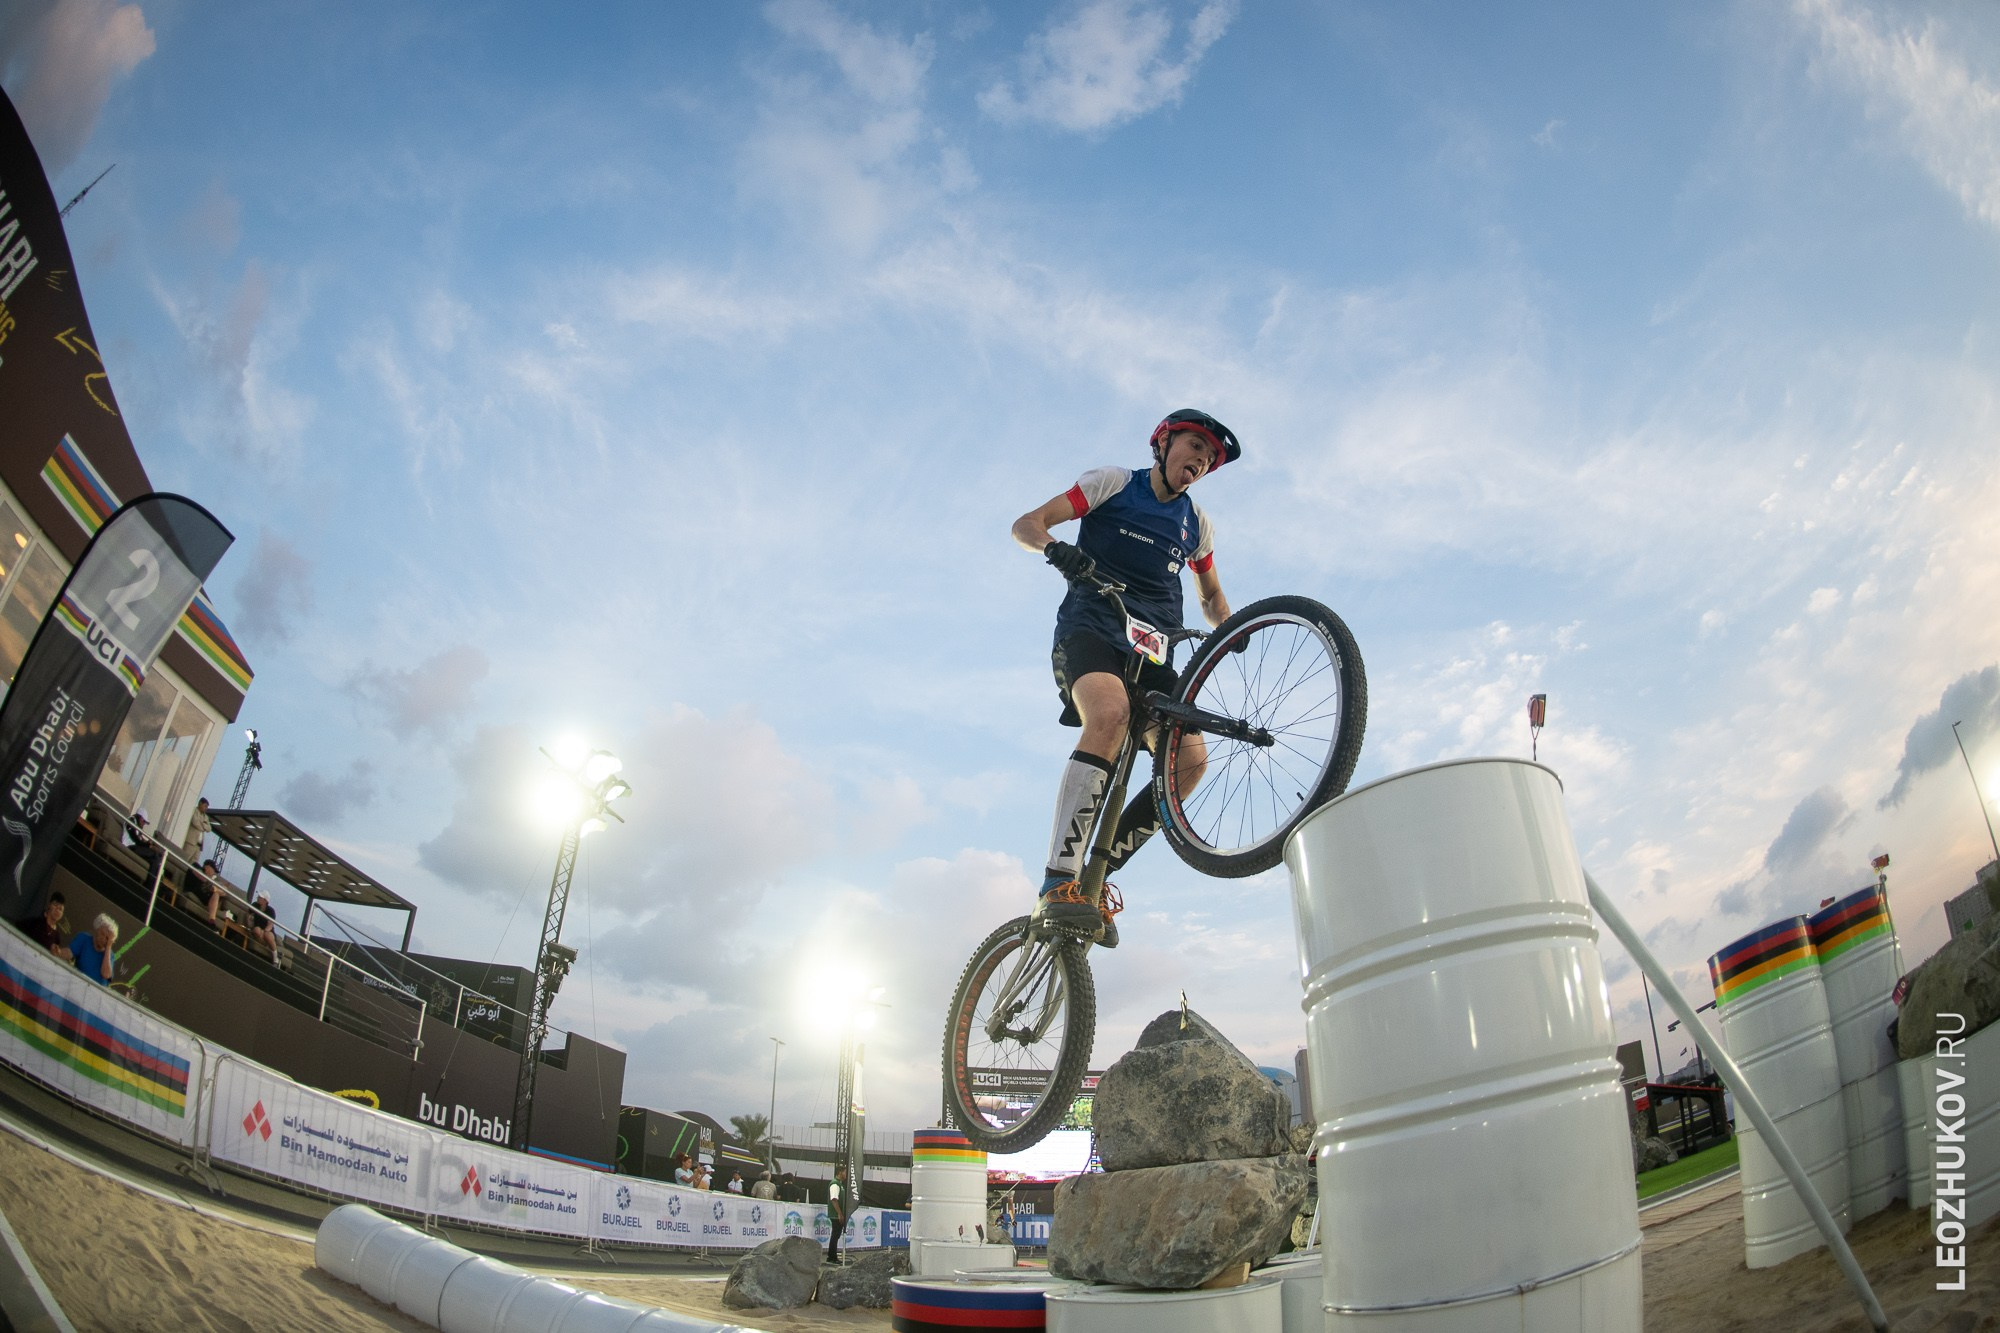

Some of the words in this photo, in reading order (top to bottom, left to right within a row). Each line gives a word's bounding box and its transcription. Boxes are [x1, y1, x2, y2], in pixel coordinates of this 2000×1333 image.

[105, 549, 160, 631] 2
[86, 621, 121, 665] UCI
[10, 758, 39, 811] Abu
[30, 686, 70, 758] Dhabi
[26, 764, 58, 823] Sports
[50, 700, 85, 764] Council
[978, 1073, 999, 1084] UCI
[453, 1104, 511, 1144] Dhabi
[280, 1135, 303, 1153] Bin
[307, 1144, 376, 1174] Hamoodah
[379, 1167, 408, 1183] Auto
[394, 1153, 409, 1167] بن
[488, 1190, 503, 1203] Bin
[506, 1194, 554, 1211] Hamoodah
[557, 1202, 577, 1214] Auto
[602, 1213, 642, 1228] BURJEEL
[656, 1220, 690, 1233] BURJEEL
[703, 1224, 732, 1236] BURJEEL
[742, 1227, 768, 1237] BURJEEL
